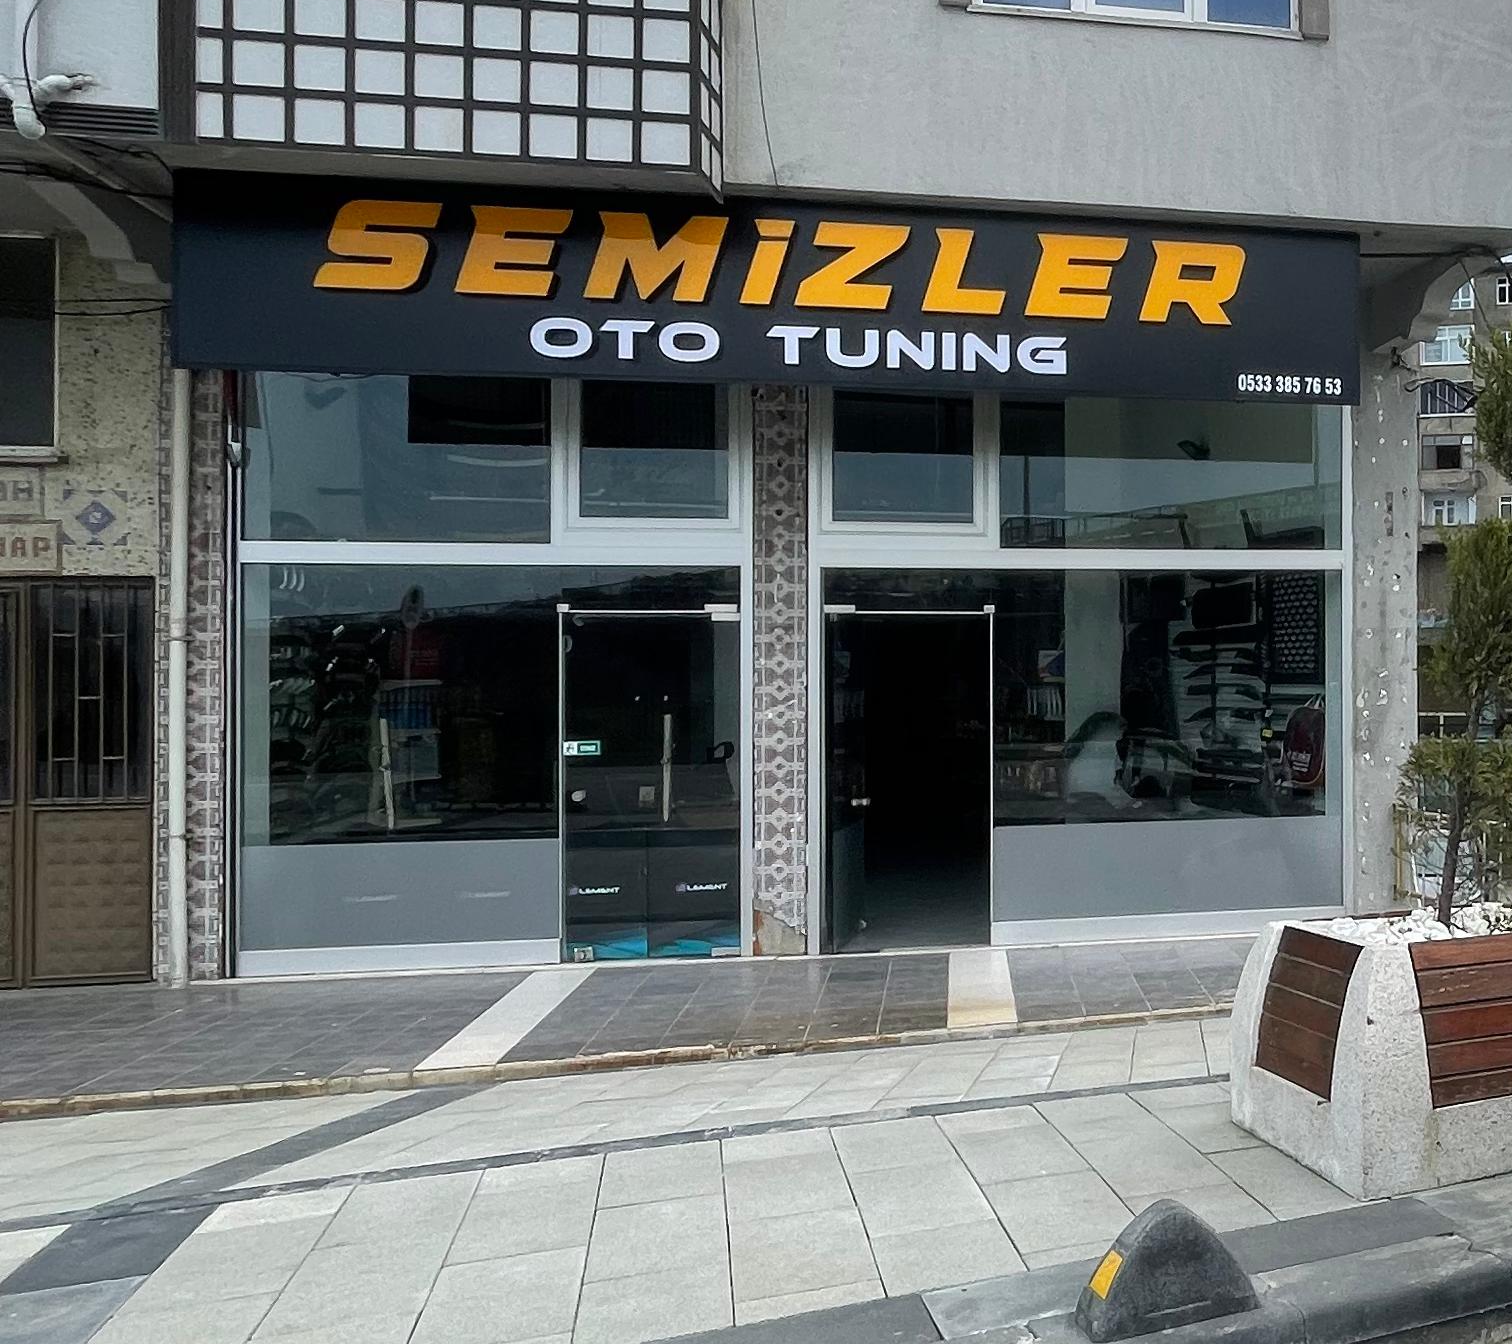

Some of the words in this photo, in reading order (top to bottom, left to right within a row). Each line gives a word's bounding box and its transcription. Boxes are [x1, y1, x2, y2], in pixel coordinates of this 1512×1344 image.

[528, 316, 721, 363] OTO
[765, 324, 1068, 375] TUNING
[1237, 374, 1273, 393] 0533
[1275, 375, 1301, 394] 385
[1304, 377, 1321, 394] 76
[1325, 378, 1342, 396] 53
